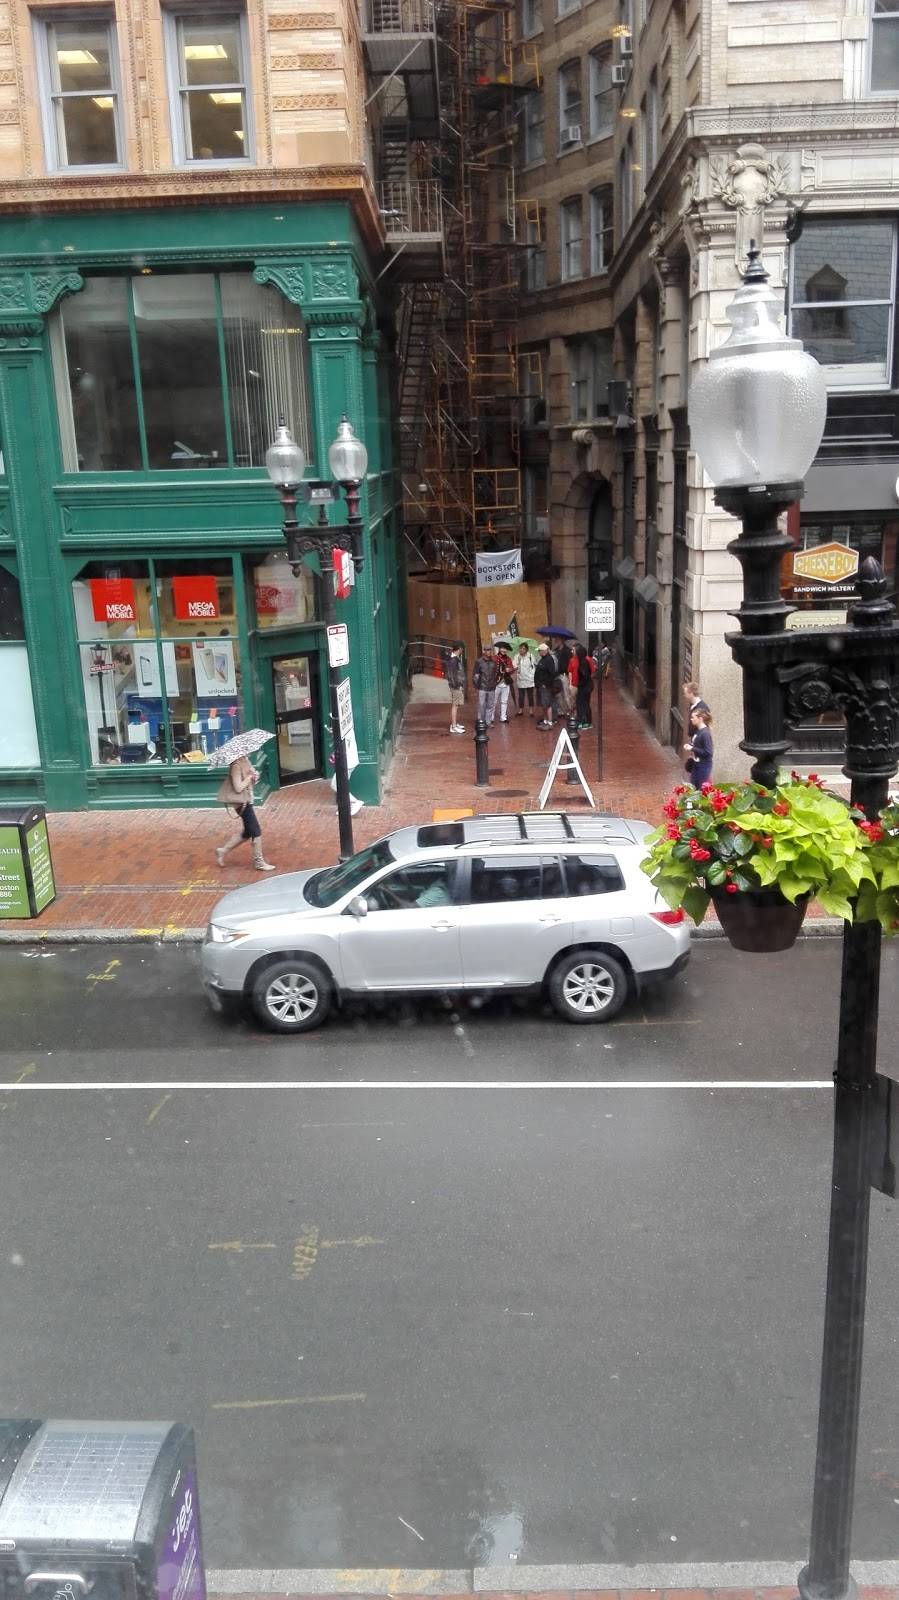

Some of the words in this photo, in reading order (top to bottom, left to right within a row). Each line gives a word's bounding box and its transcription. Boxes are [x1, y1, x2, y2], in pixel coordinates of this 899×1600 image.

[477, 563, 521, 574] BOOKSTORE
[795, 552, 857, 577] CHEESEBOY
[496, 573, 515, 581] OPEN
[106, 603, 133, 613] MEGA
[188, 601, 215, 611] MEGA
[189, 609, 216, 617] MOBILE
[588, 606, 612, 615] VEHICLES
[107, 611, 134, 619] MOBILE
[588, 616, 612, 624] EXCLUDED
[207, 687, 235, 695] unlocked
